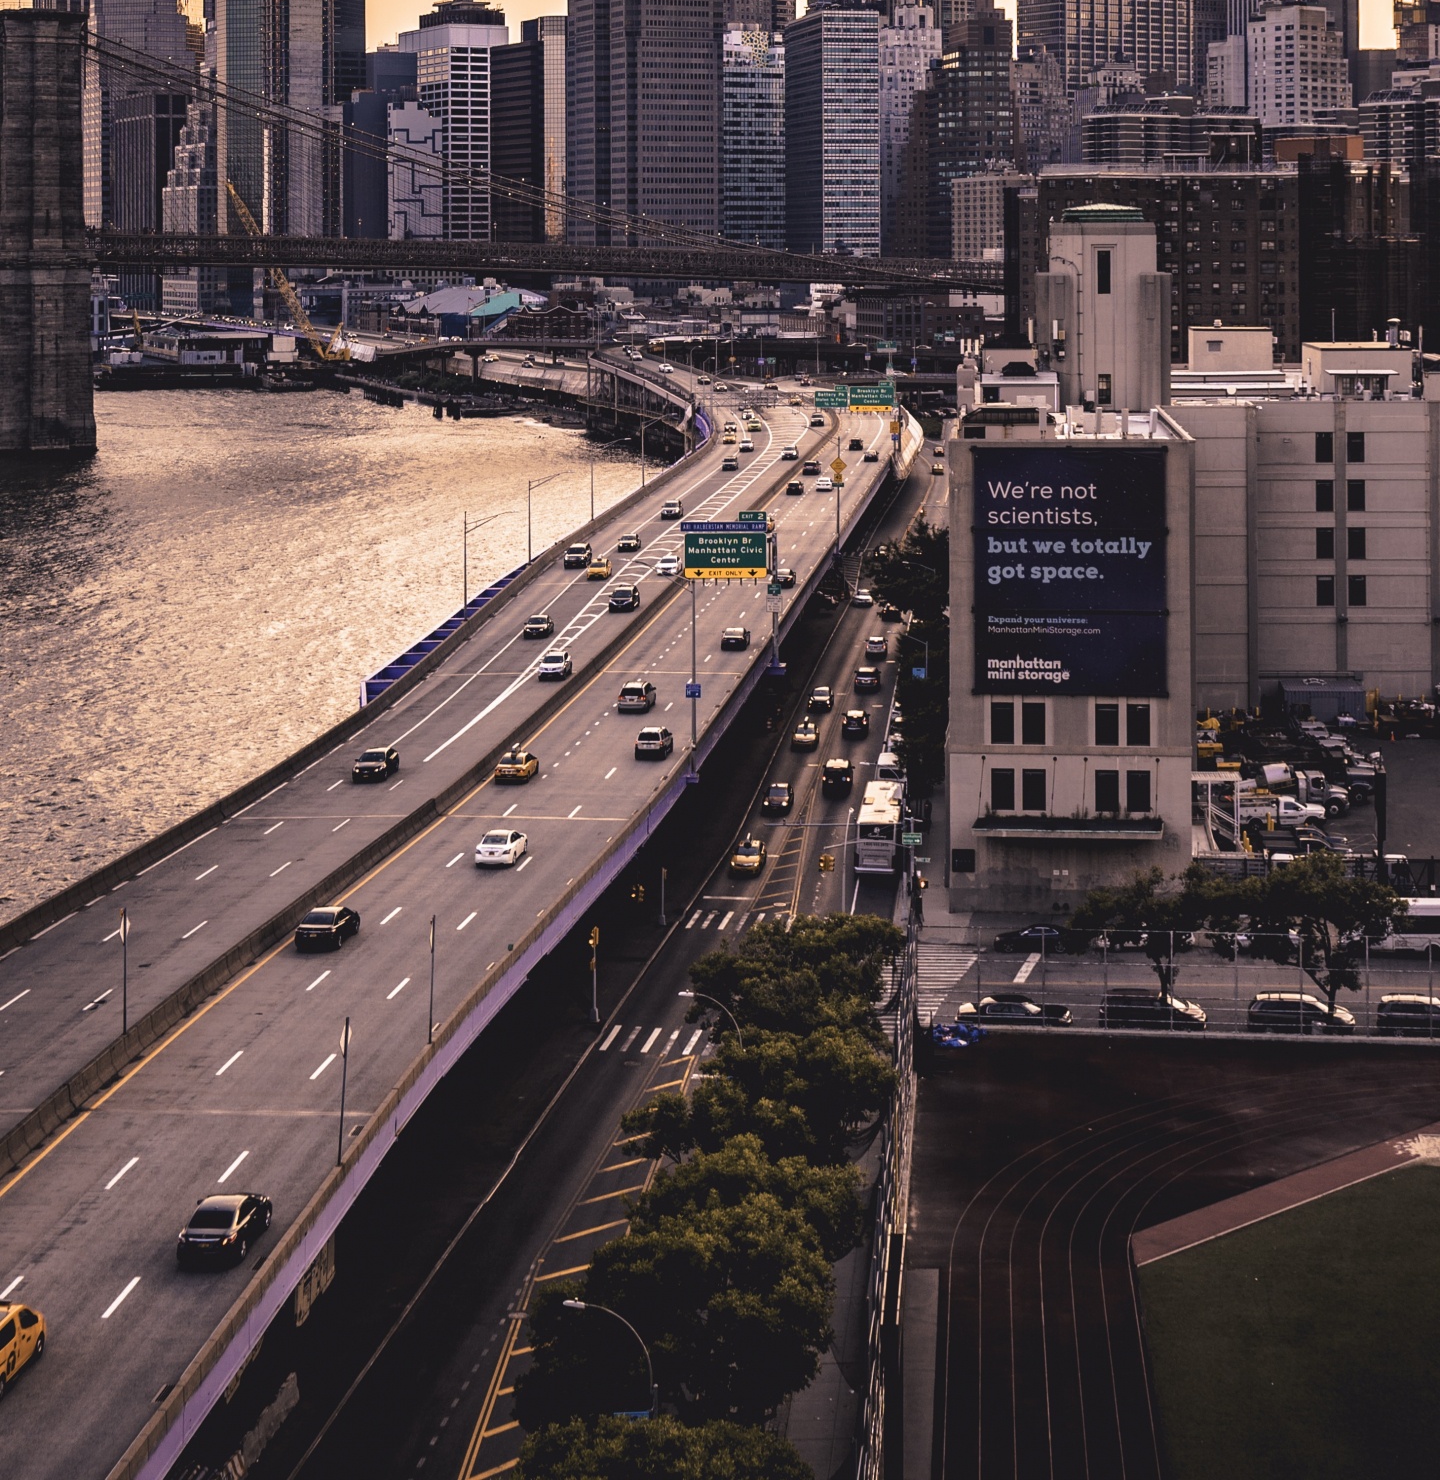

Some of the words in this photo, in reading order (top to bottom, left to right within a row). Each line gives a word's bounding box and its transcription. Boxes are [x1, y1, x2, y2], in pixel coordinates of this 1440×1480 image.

[988, 481, 1053, 499] We're
[1061, 483, 1097, 499] not
[988, 507, 1098, 526] scientists,
[988, 537, 1028, 554] but
[1033, 541, 1066, 554] we
[1071, 537, 1152, 558] totally
[988, 563, 1025, 584] got
[1030, 566, 1104, 583] space.
[988, 616, 1022, 625] Expand
[988, 626, 1100, 635] ManhattanMiniStorage.com
[988, 654, 1061, 669] manhattan
[988, 668, 1015, 680] mini
[1018, 670, 1070, 683] storage
